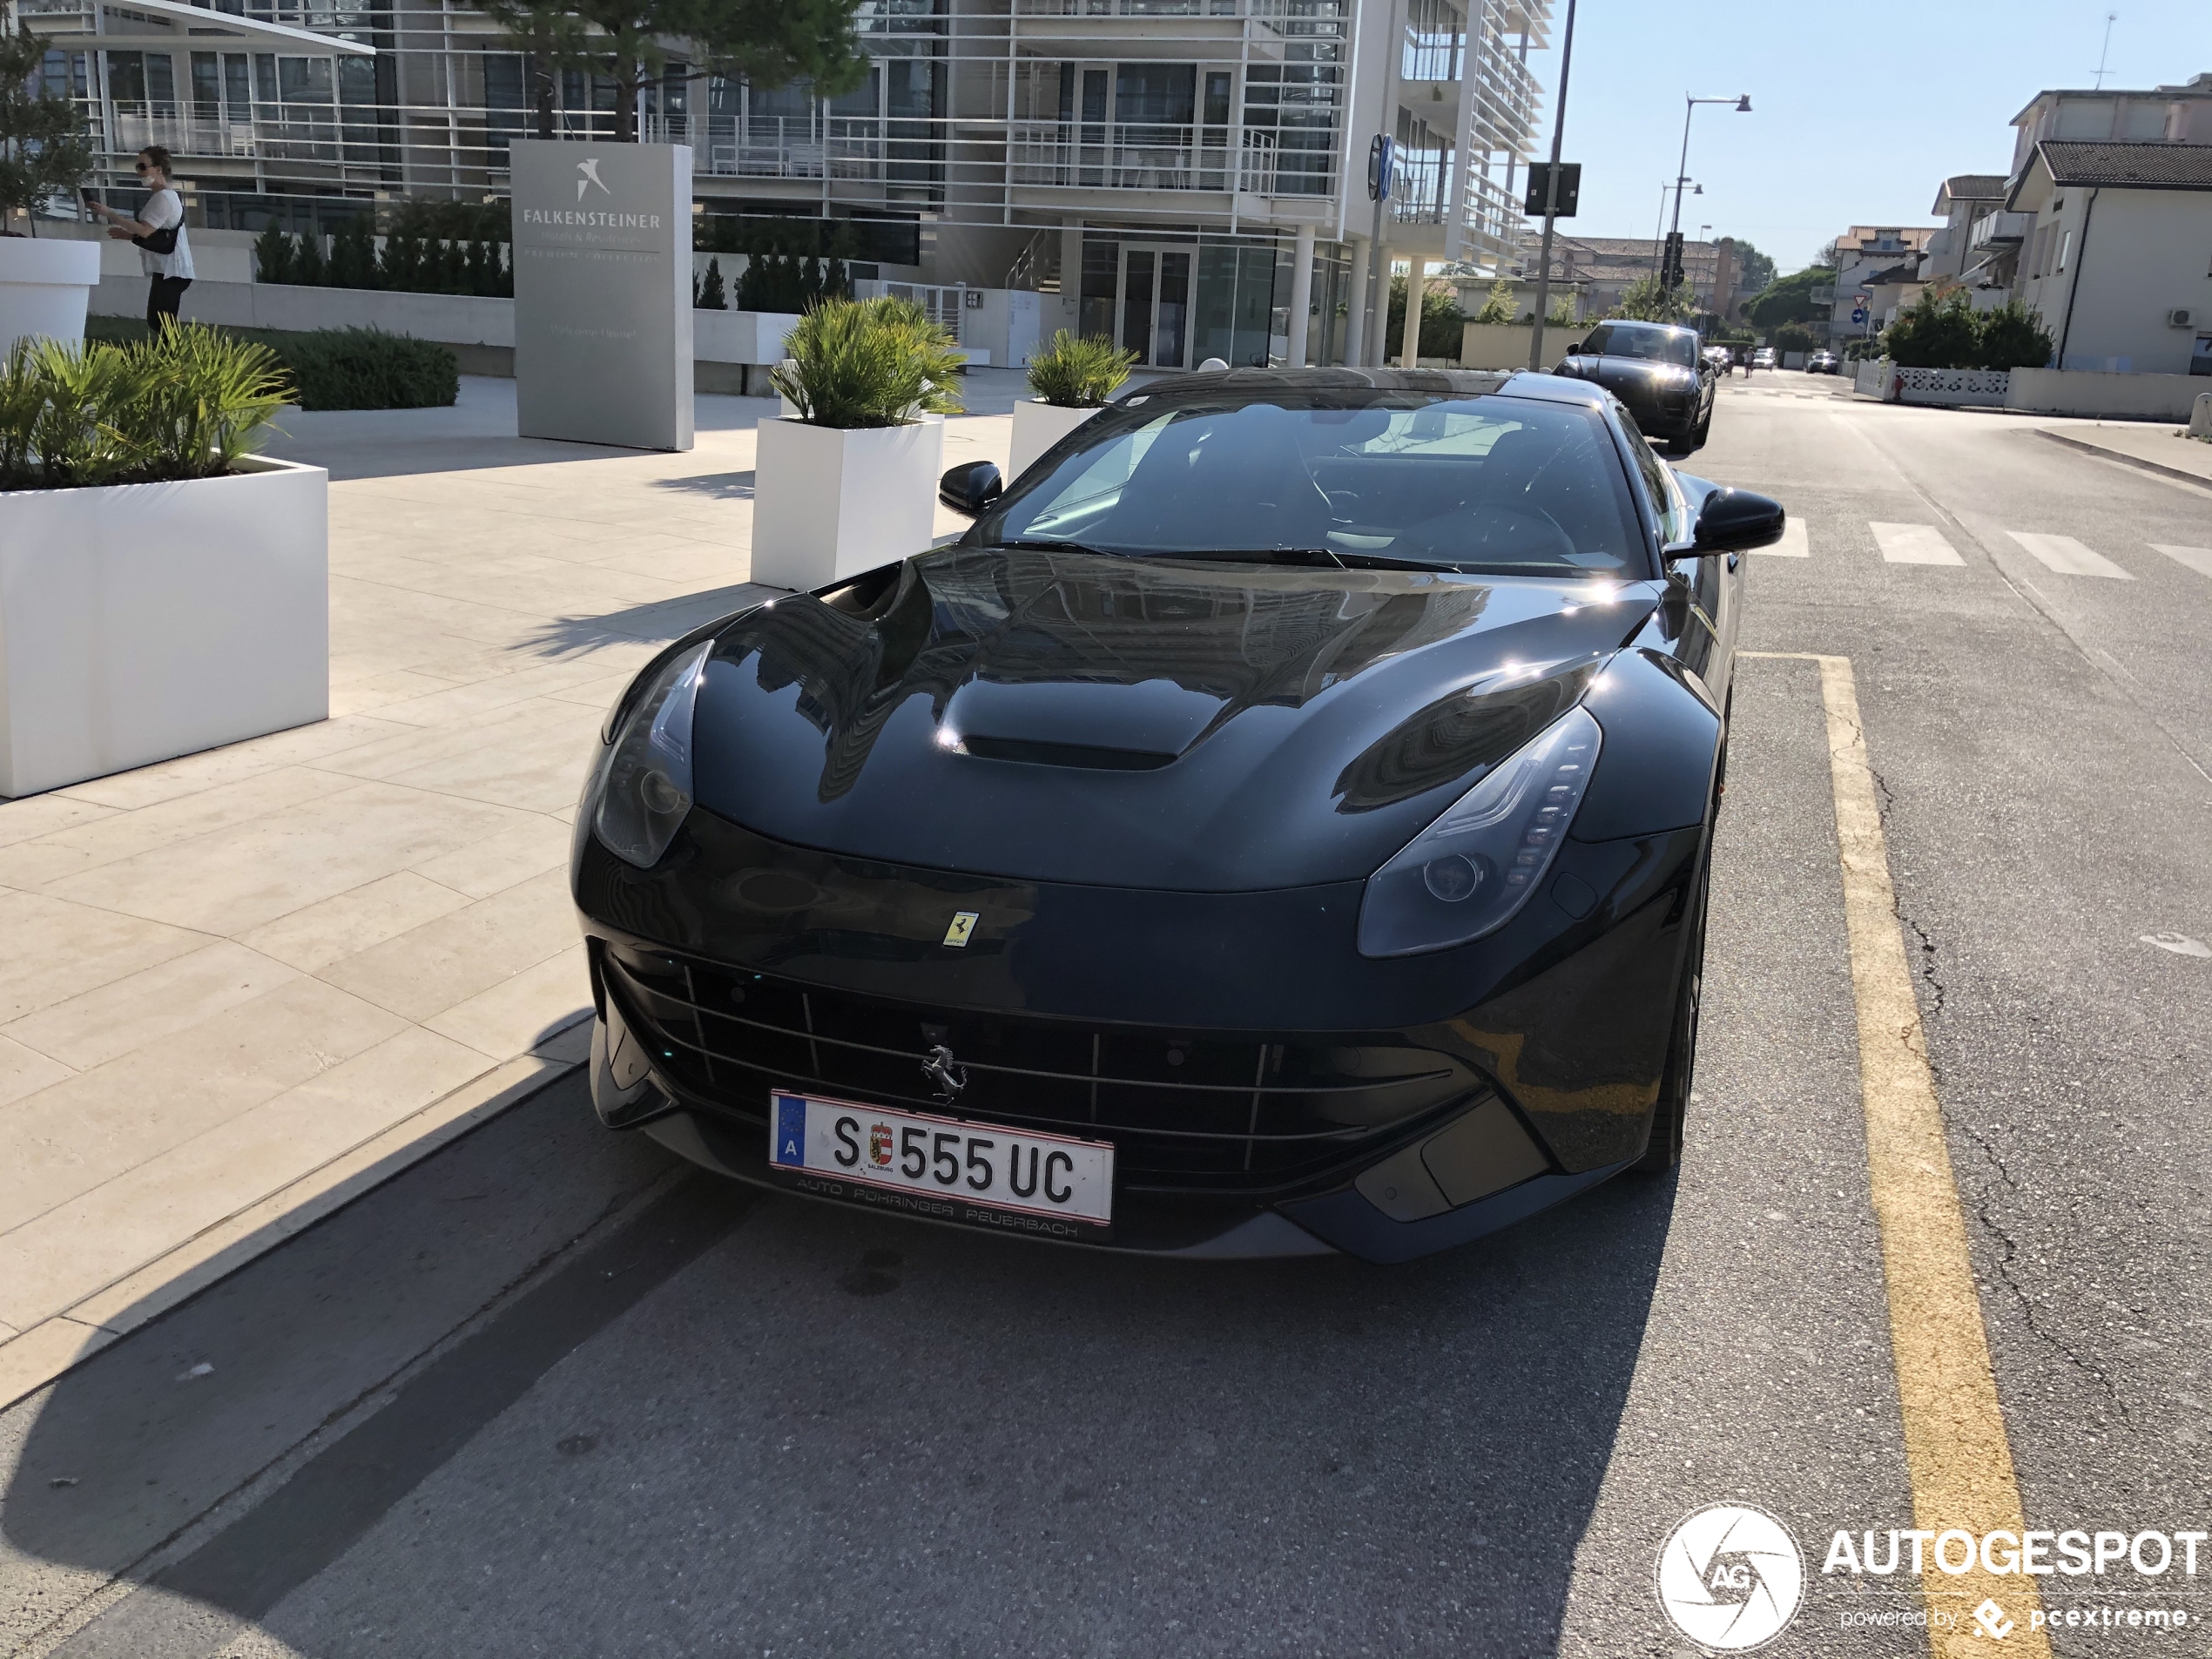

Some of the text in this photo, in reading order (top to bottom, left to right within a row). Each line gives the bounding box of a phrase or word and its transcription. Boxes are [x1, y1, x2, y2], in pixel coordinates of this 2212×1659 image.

[523, 208, 660, 228] FALKENSTEINER
[785, 1140, 797, 1156] A
[834, 1116, 1073, 1204] S 555 UC
[867, 1163, 894, 1173] SALZBURG
[798, 1178, 1078, 1237] AUTO PÜHRINGER PEUERBACH
